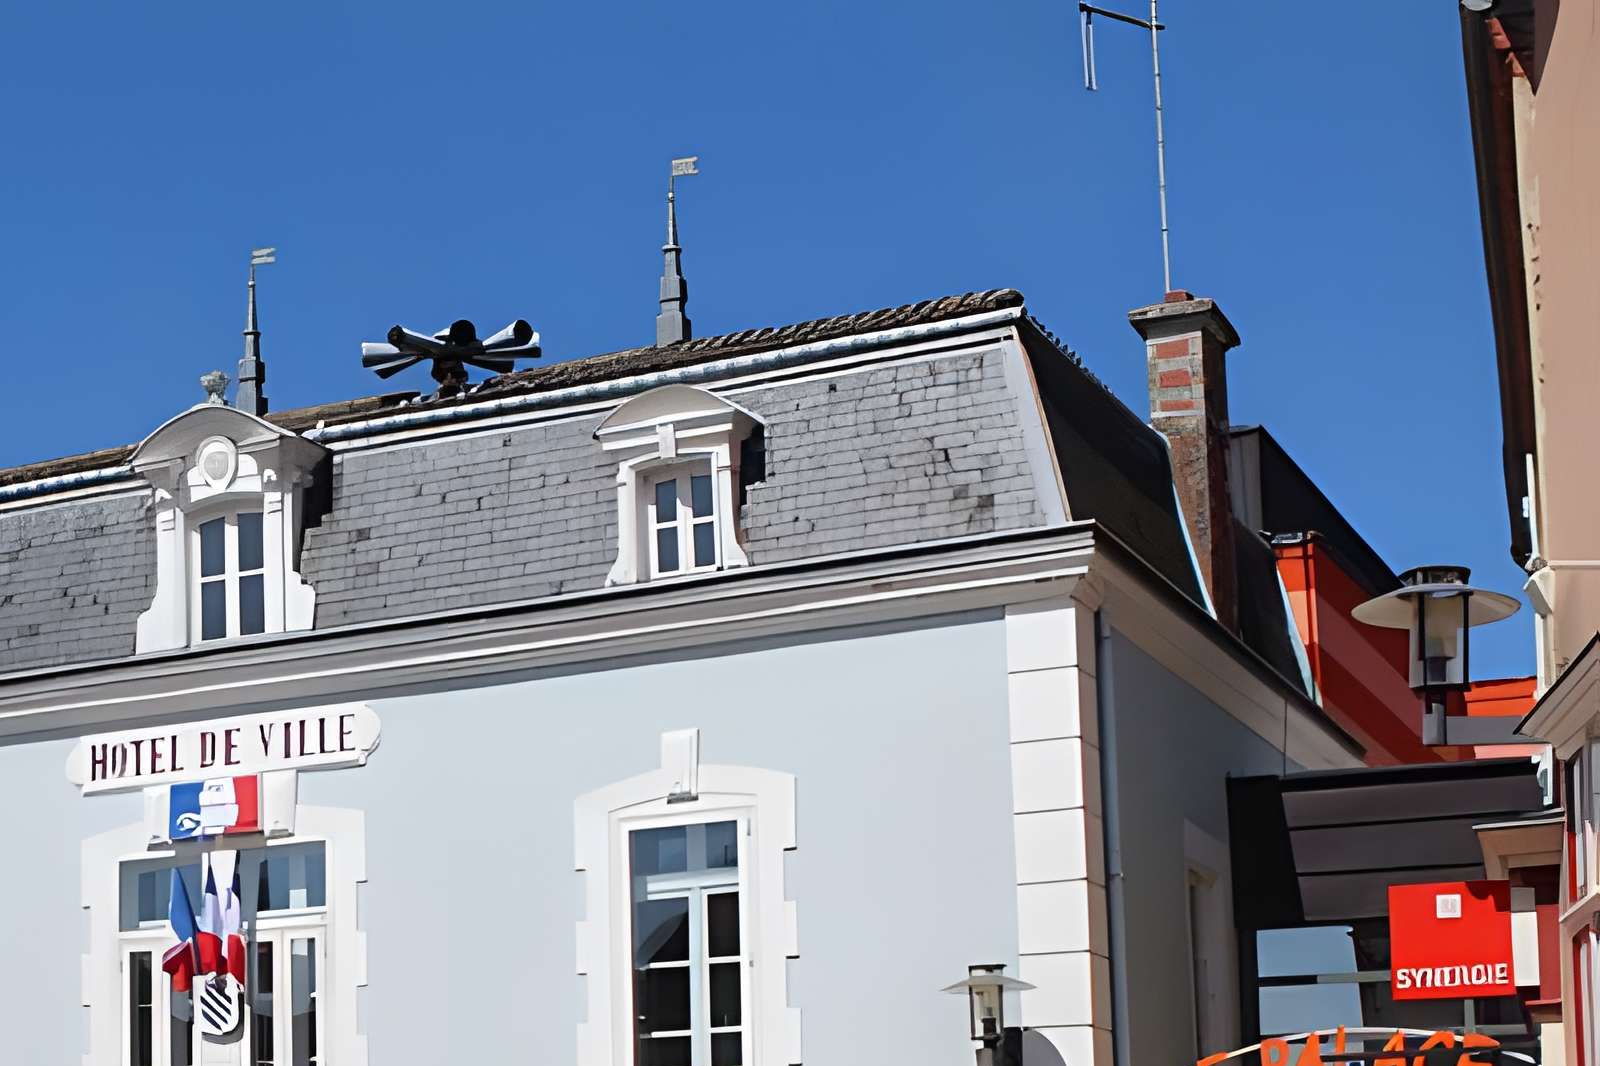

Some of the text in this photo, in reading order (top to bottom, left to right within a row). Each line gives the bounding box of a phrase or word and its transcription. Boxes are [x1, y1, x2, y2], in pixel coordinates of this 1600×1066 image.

[90, 713, 357, 782] HOTEL DE VILLE
